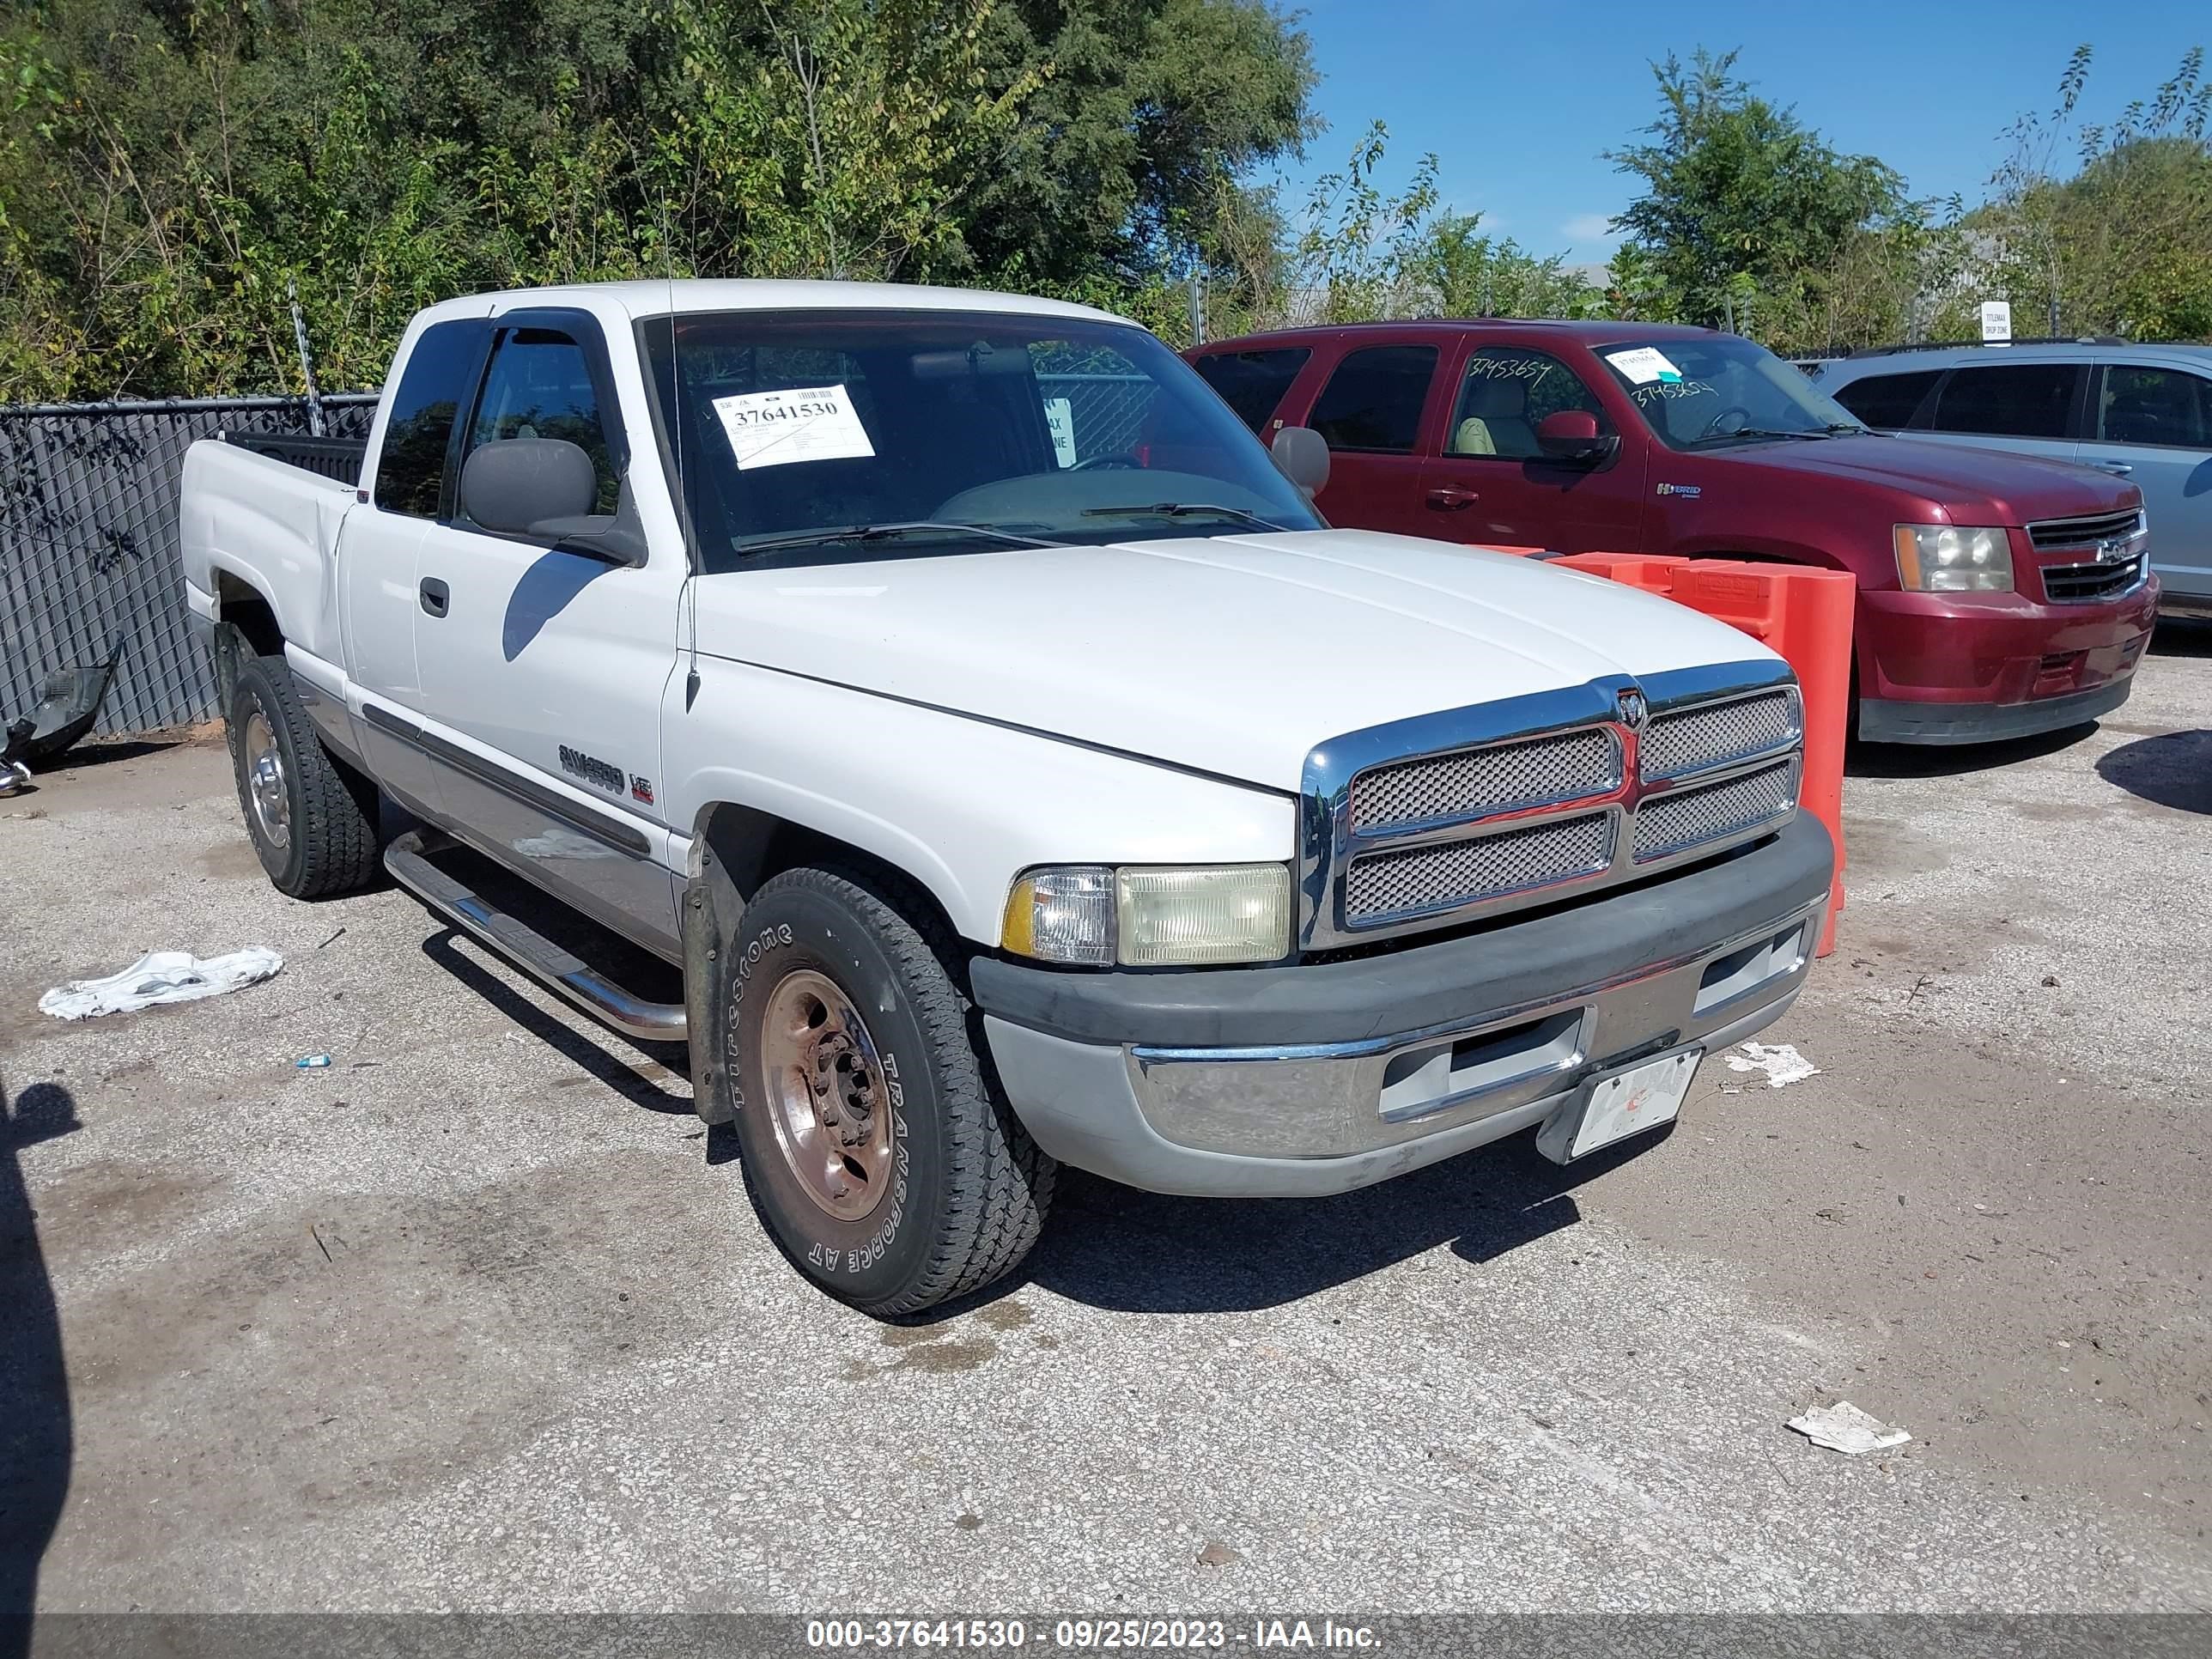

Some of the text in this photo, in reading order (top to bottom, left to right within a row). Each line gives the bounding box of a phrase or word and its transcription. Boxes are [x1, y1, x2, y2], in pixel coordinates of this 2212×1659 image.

[735, 402, 838, 426] 37641530
[808, 1053, 909, 1274] TRANSFORCE AT
